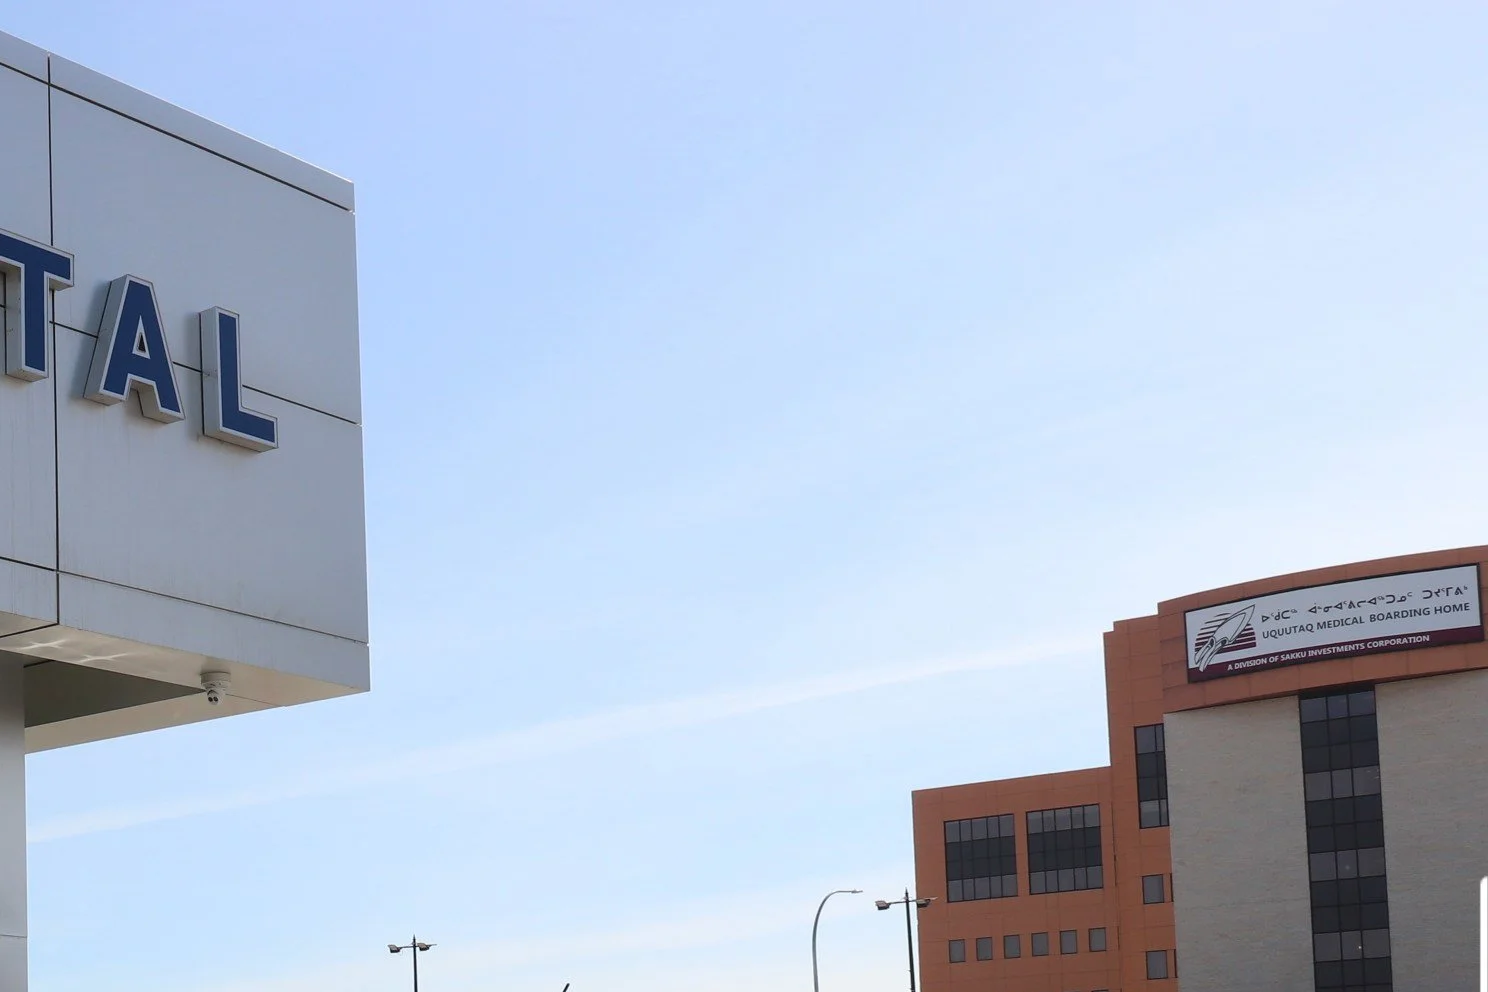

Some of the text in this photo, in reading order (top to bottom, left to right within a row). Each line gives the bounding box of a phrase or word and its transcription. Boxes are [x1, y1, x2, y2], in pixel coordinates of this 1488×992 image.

[1262, 602, 1470, 639] UQUUTAQ MEDICAL BOARDING HOME
[1234, 657, 1267, 670] DIVISION
[1269, 655, 1279, 663] OF
[1280, 651, 1307, 661] SAKKU
[1308, 643, 1365, 657] INVESTMENTS
[1366, 635, 1430, 649] CORPORATION
